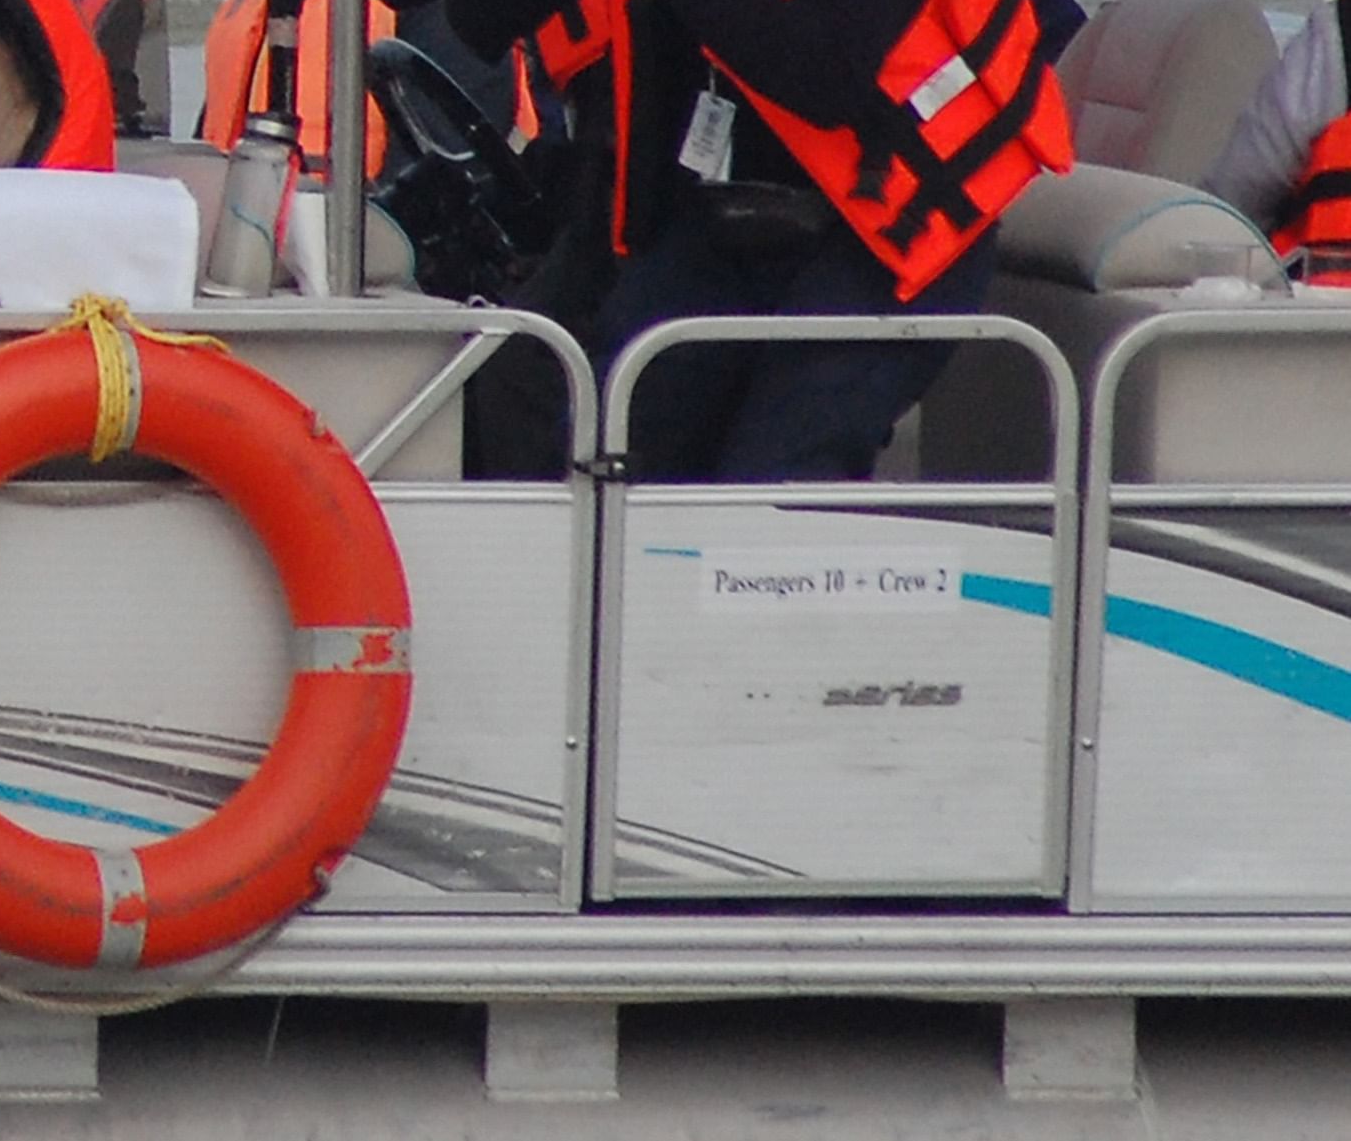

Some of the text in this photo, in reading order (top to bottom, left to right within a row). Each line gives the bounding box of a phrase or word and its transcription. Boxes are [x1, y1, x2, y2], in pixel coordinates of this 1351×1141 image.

[715, 568, 816, 597] Passengers
[825, 568, 845, 593] 10
[878, 567, 926, 593] Crew
[935, 568, 947, 593] 2
